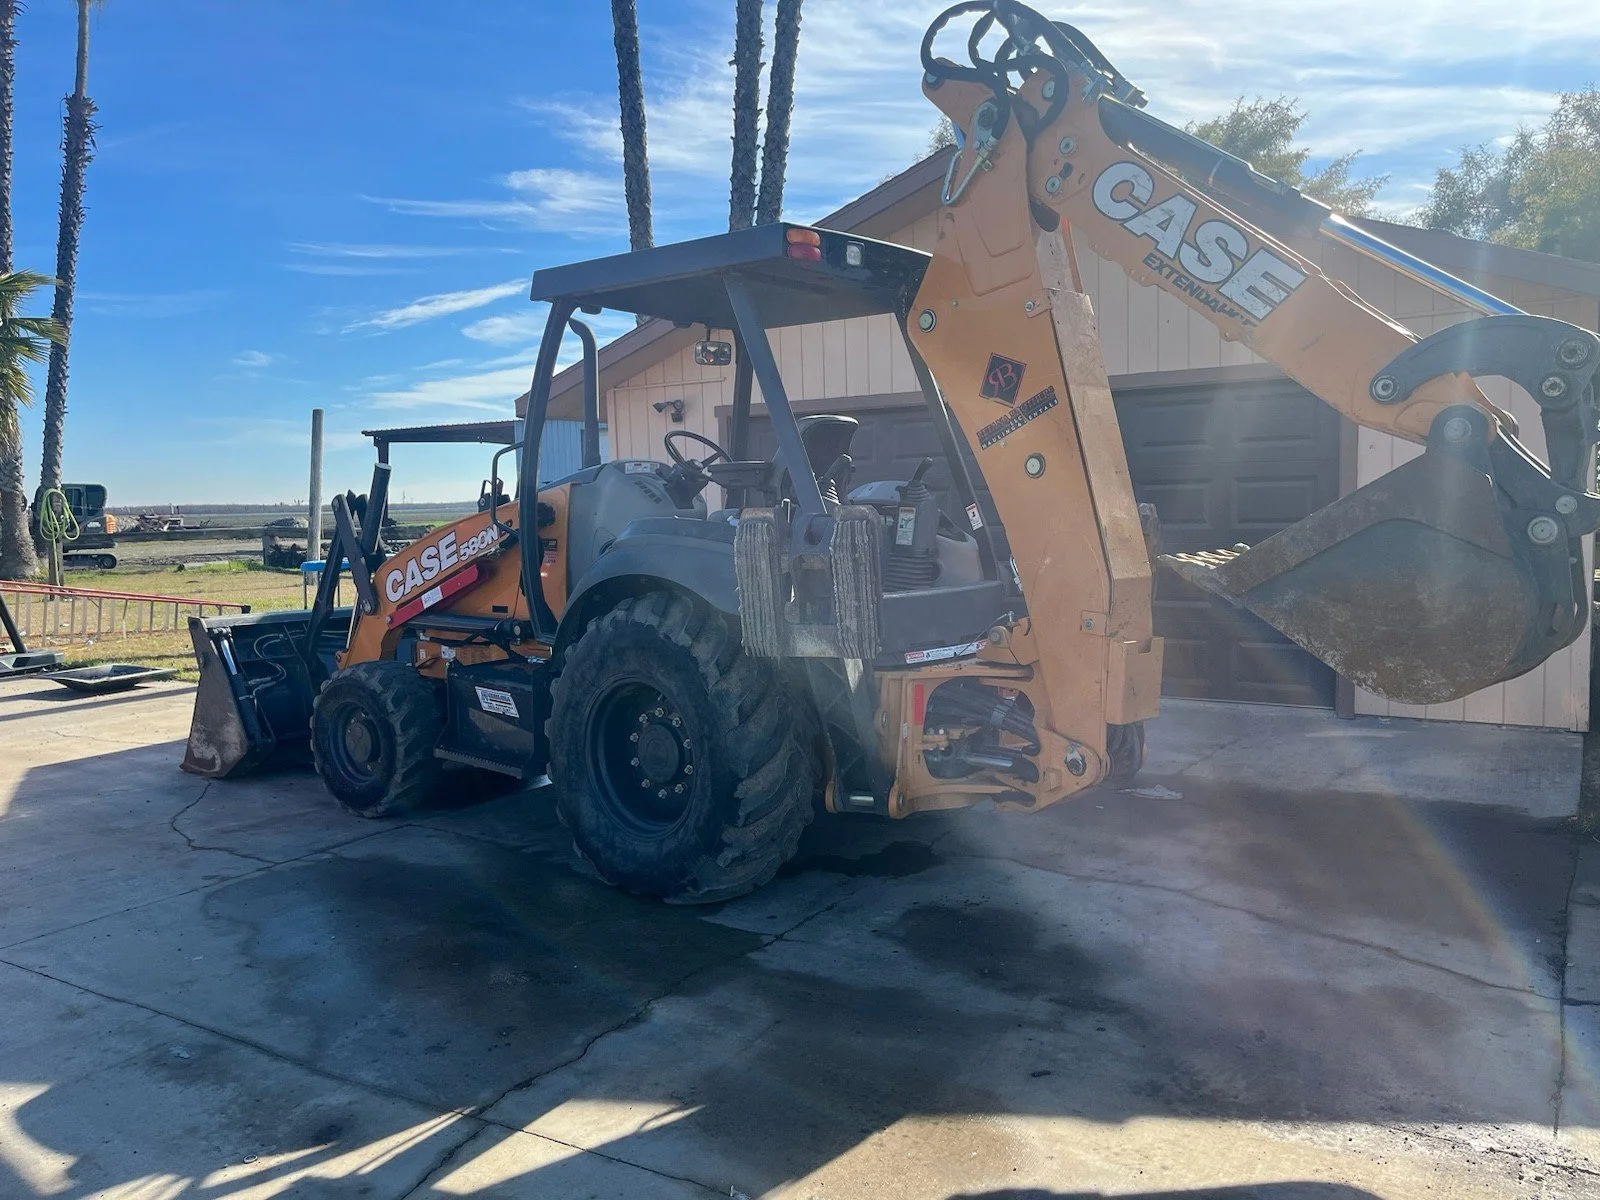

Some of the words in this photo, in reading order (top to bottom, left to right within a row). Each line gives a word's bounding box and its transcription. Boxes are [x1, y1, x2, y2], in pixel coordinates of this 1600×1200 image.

[1092, 161, 1308, 322] CASE
[1142, 252, 1257, 328] EXTENDAH
[1024, 399, 1058, 424] ENTALS
[385, 529, 459, 603] CASE
[459, 523, 499, 561] 580N
